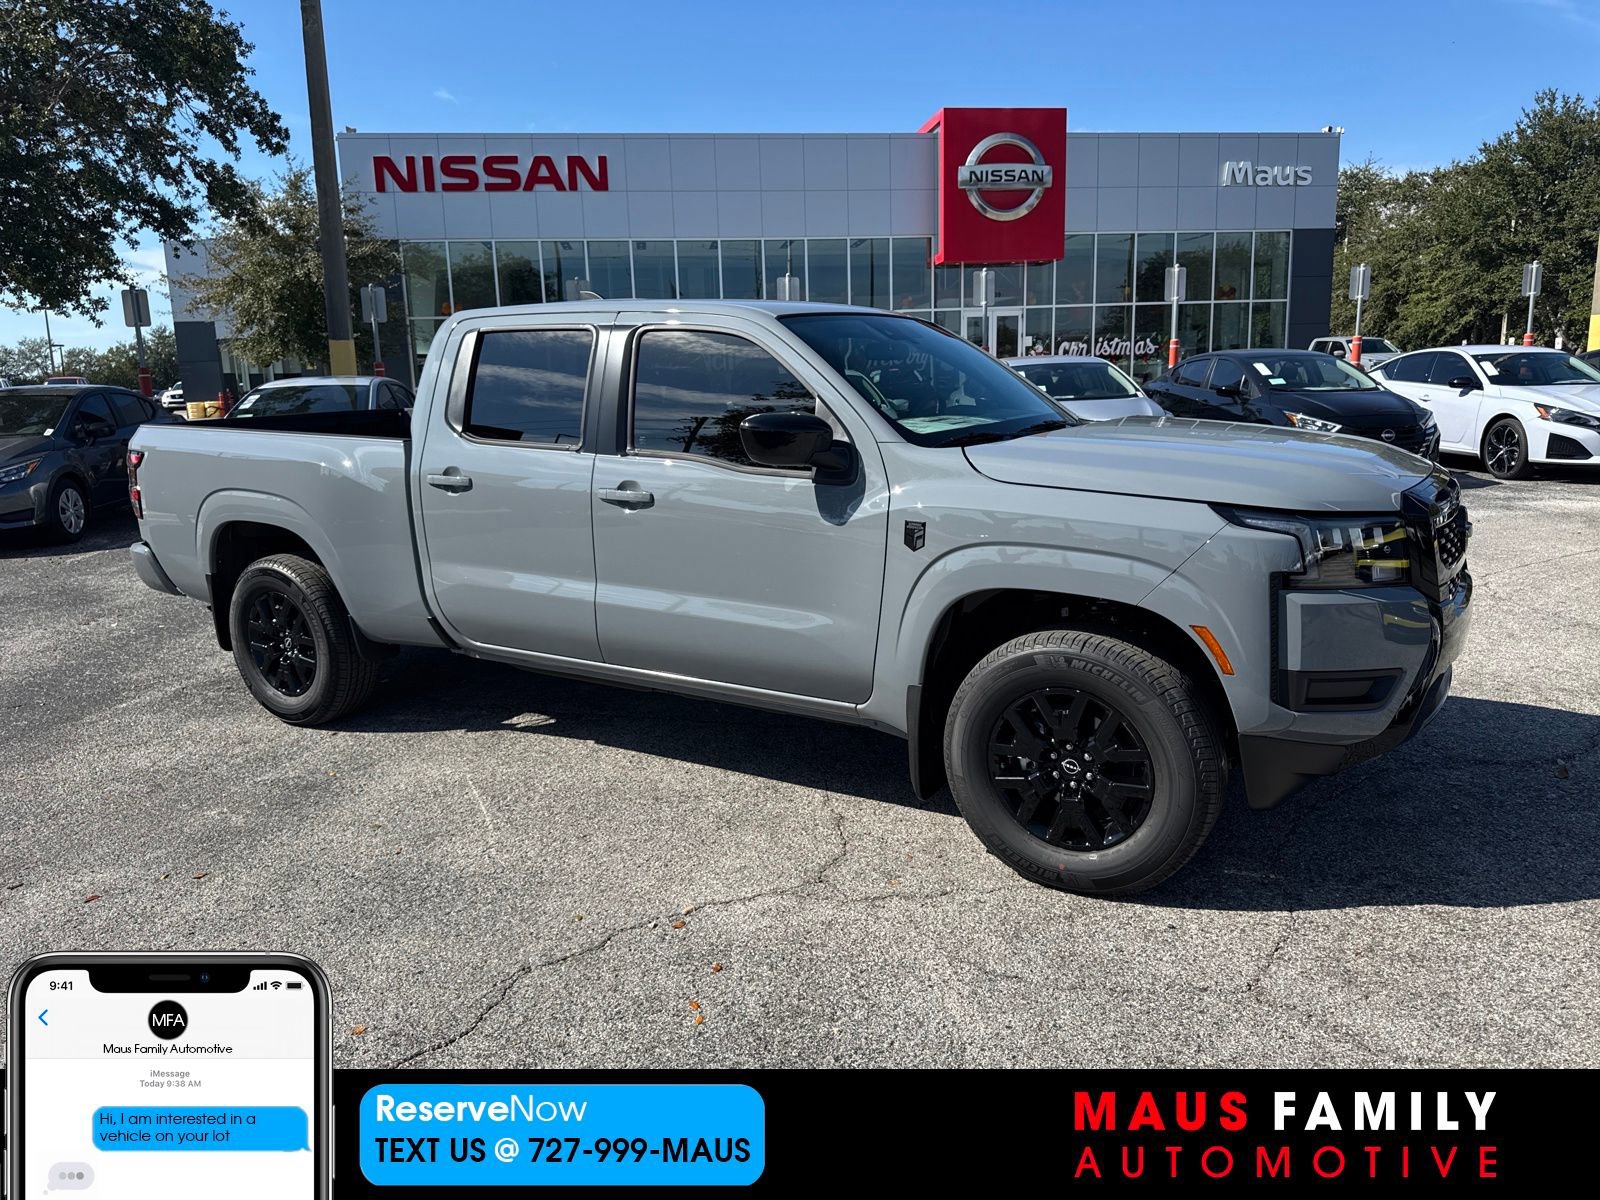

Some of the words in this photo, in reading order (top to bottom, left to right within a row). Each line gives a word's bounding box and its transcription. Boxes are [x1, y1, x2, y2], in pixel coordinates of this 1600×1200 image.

[372, 154, 609, 192] NISSAN
[968, 169, 1044, 183] NISSAN
[1222, 160, 1313, 186] Maus
[1071, 659, 1151, 704] MICHELIN
